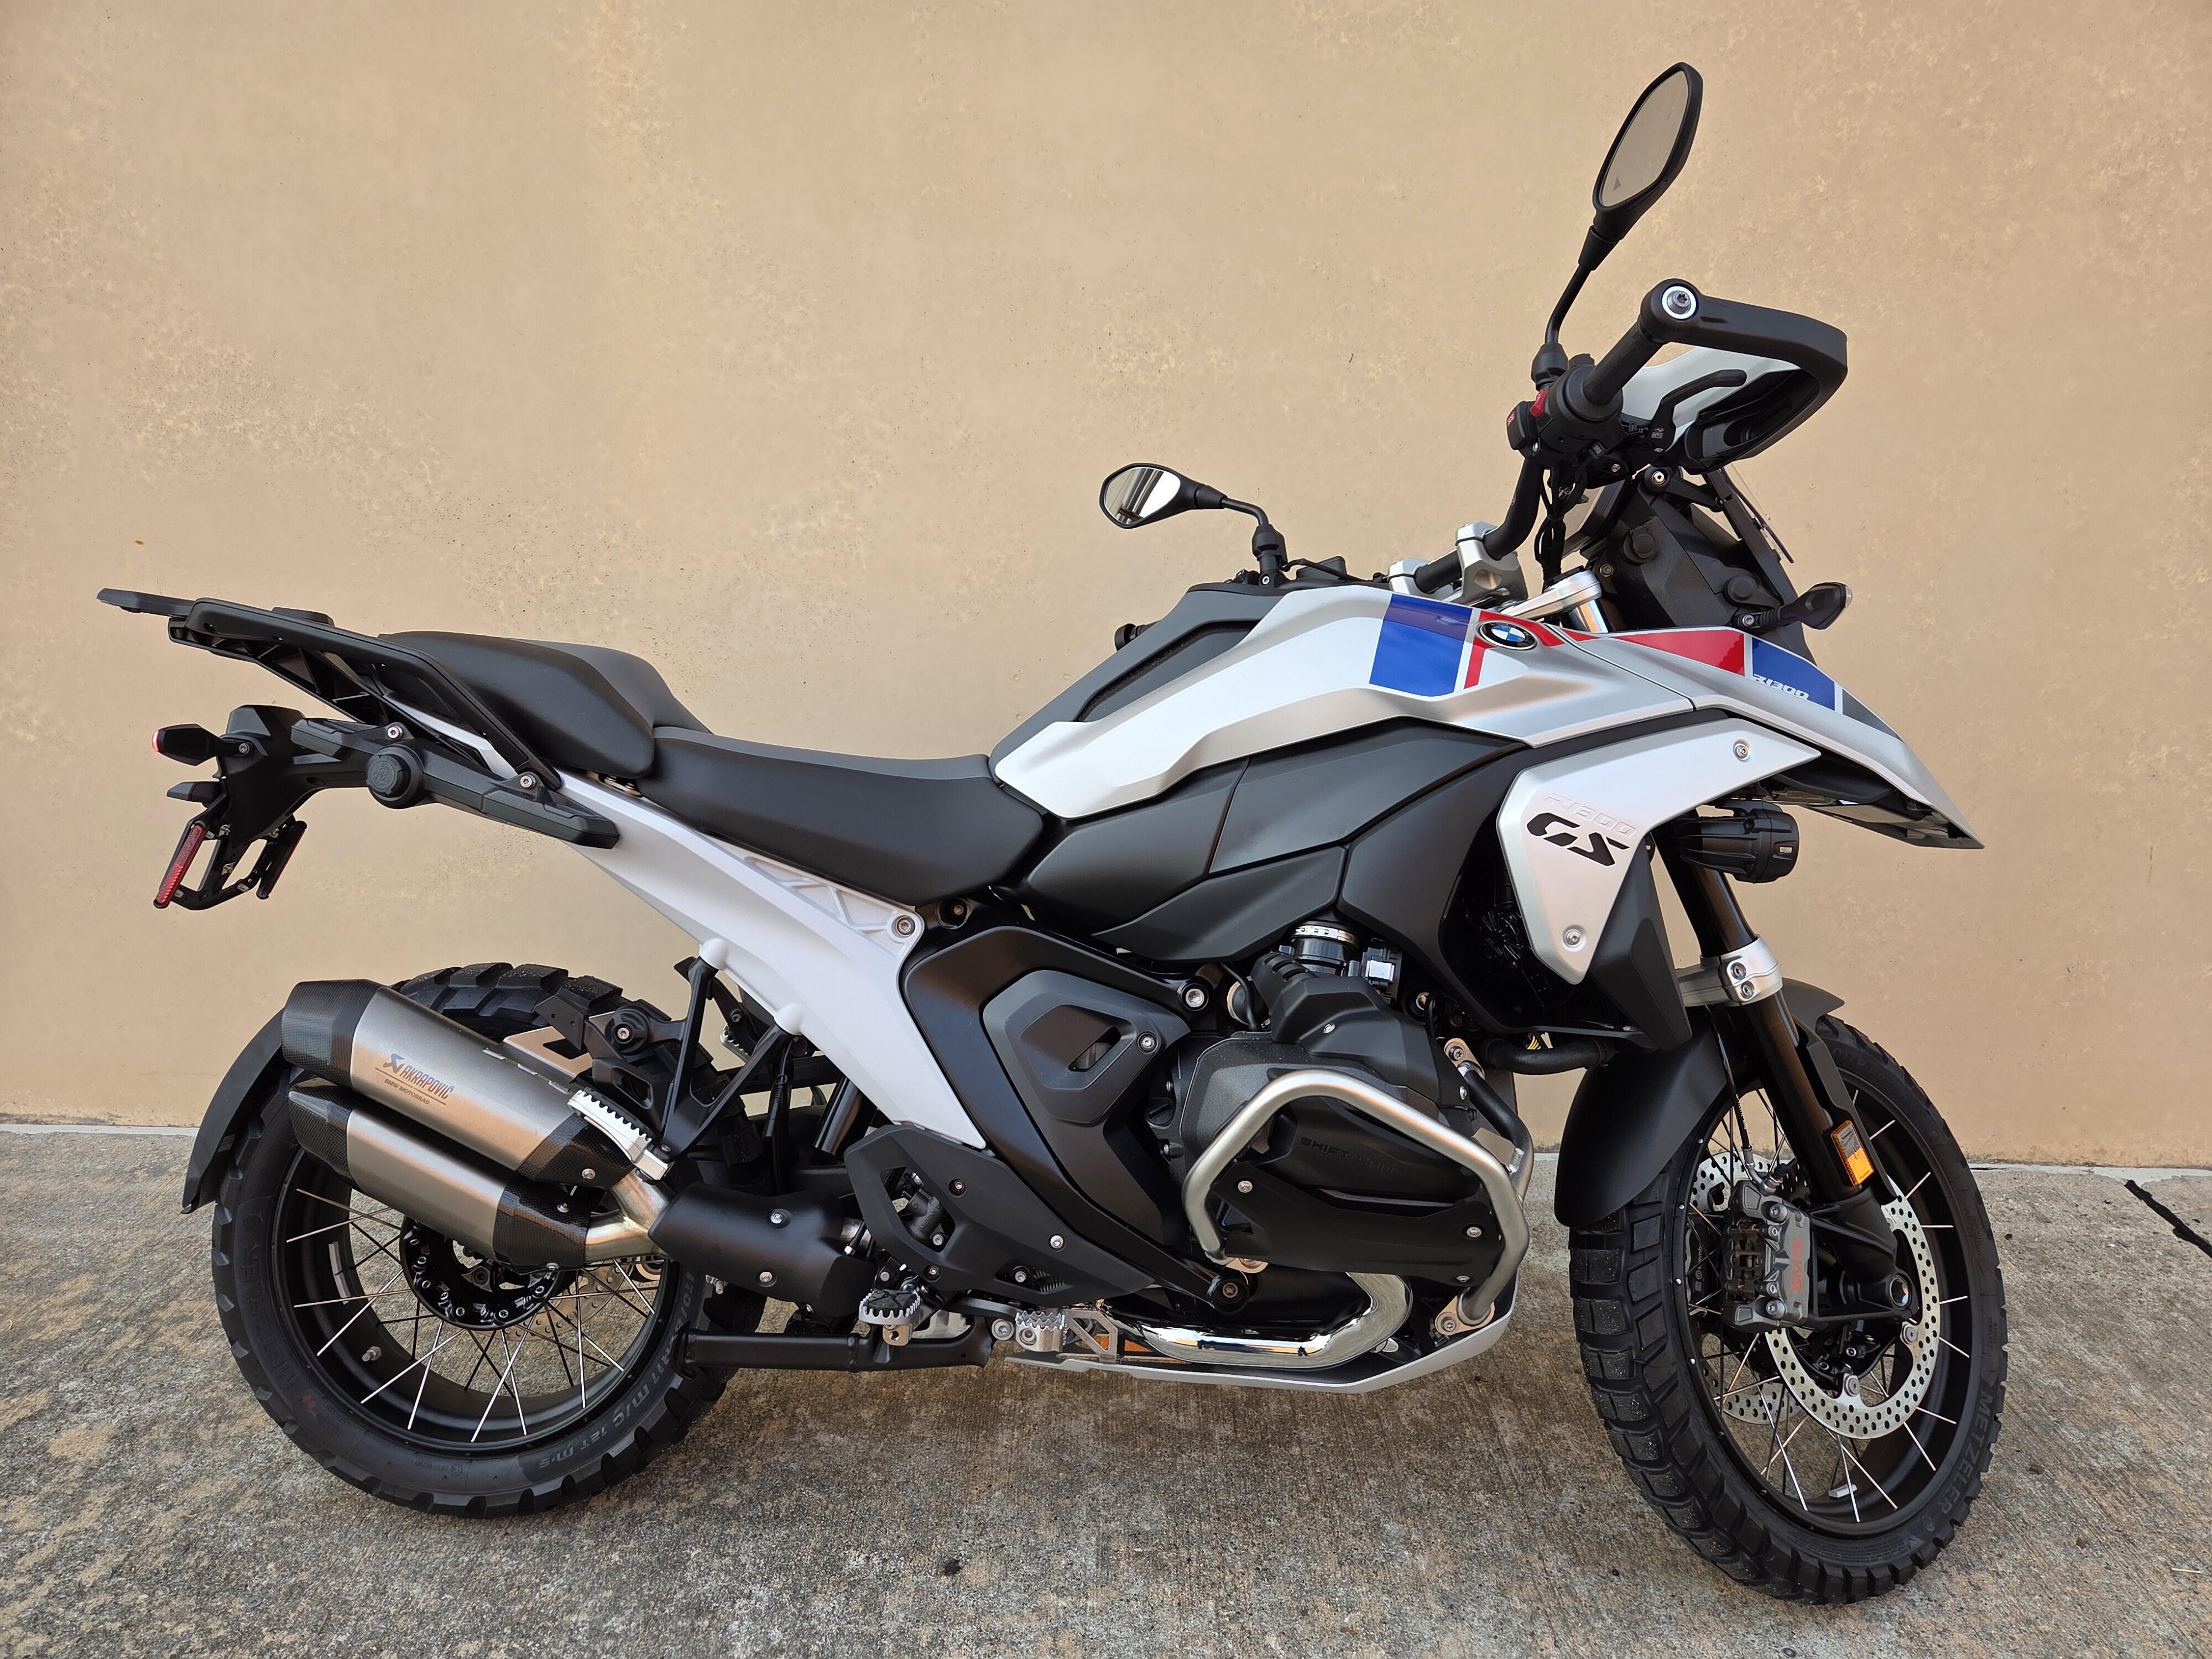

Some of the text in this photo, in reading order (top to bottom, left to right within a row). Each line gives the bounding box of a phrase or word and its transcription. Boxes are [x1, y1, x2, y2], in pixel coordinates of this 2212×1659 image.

[1527, 812, 1630, 867] GS
[384, 1078, 430, 1105] BMW MOTORRAD
[1300, 1136, 1351, 1160] SHIFT
[1791, 1238, 1804, 1292] BMW
[1938, 1391, 1994, 1515] METZELER
